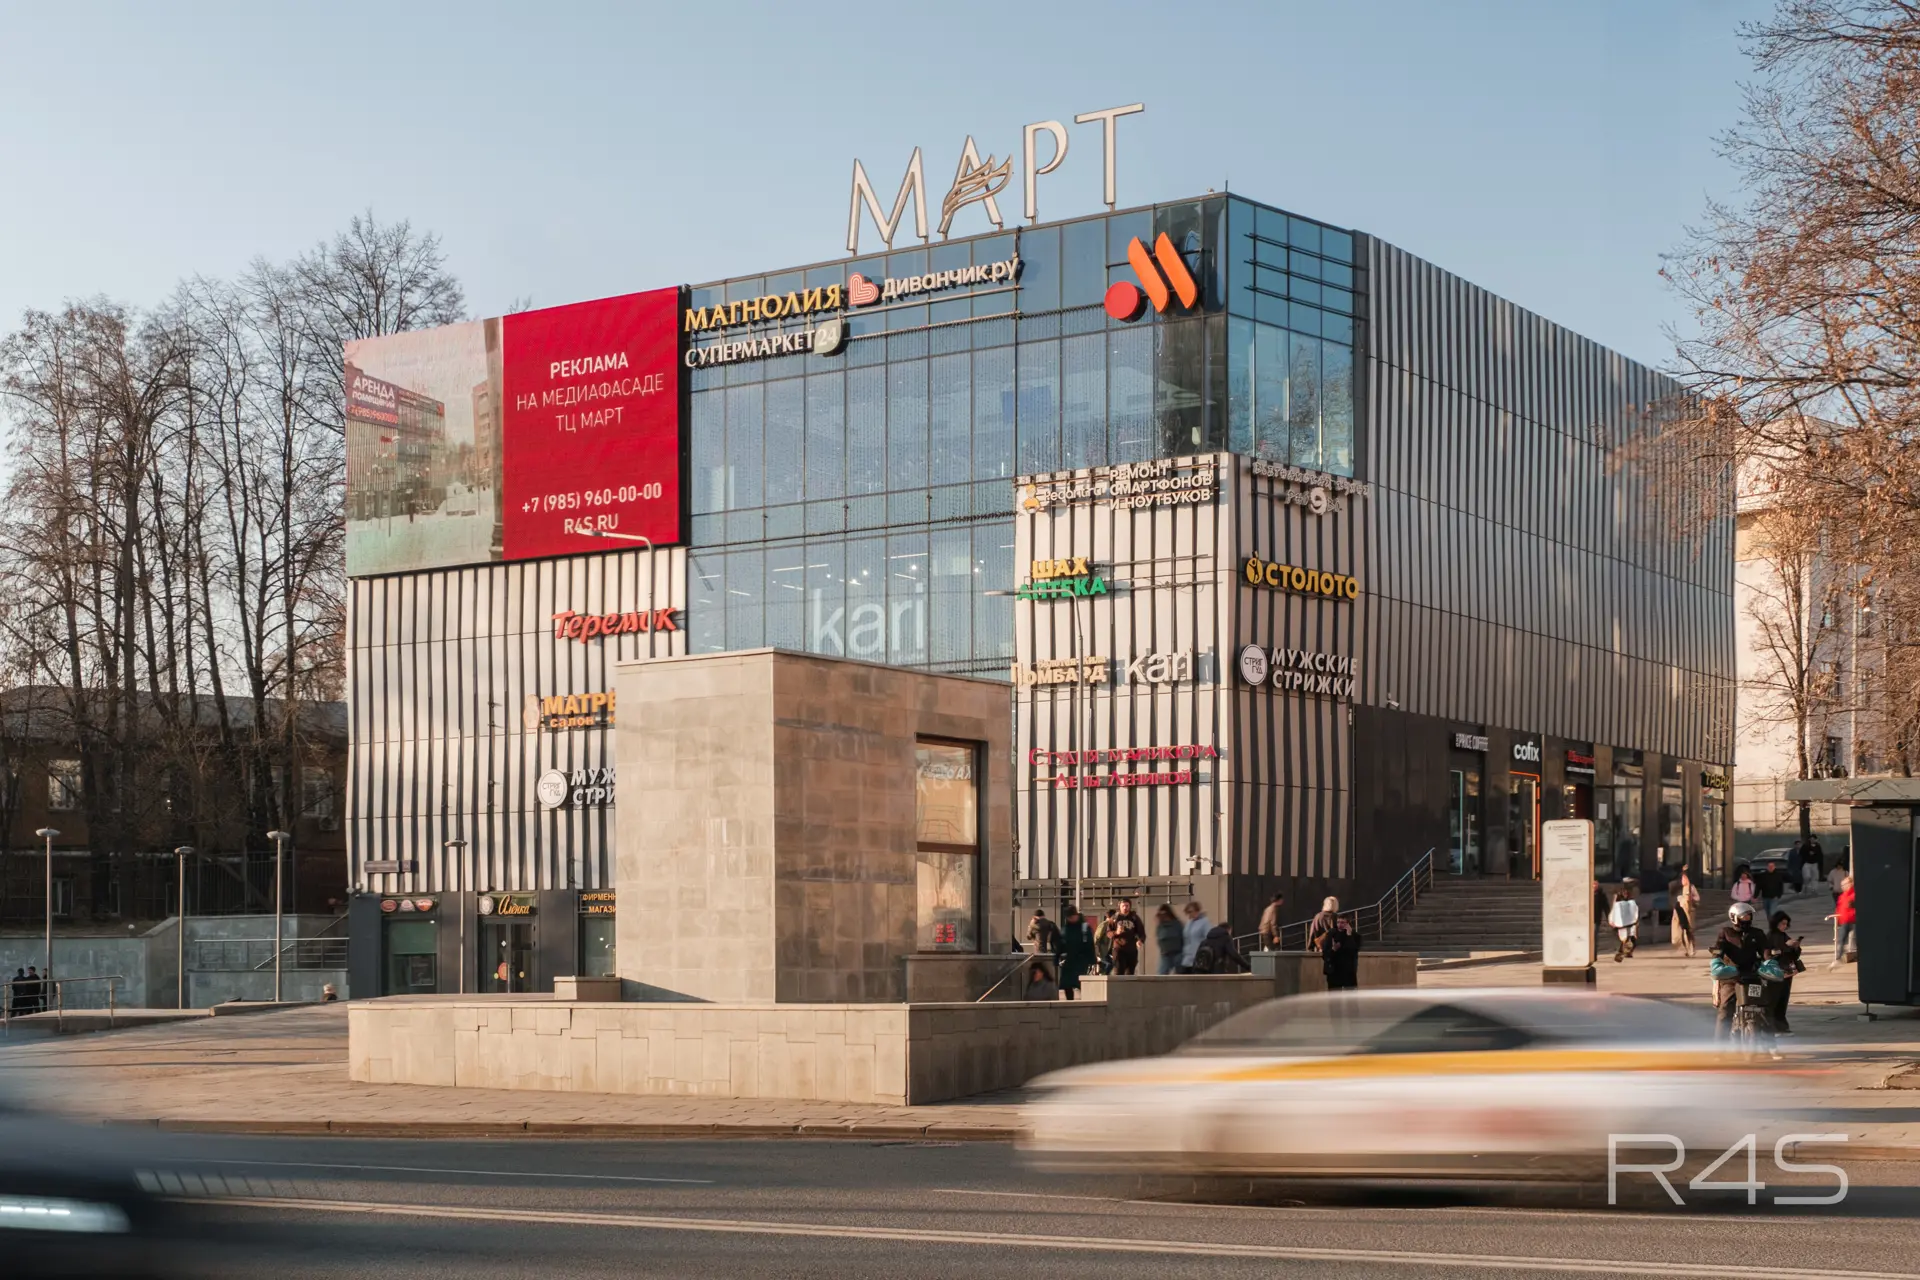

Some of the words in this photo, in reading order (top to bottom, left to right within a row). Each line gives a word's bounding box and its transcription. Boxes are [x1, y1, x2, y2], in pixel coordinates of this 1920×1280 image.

[847, 103, 1145, 251] МАРТ
[684, 284, 843, 332] МАГНОЛИЯ
[685, 330, 815, 368] СУПЕРМАРКЕТ
[818, 327, 838, 346] 24
[550, 351, 629, 379] РЕКЛАМА
[352, 375, 395, 400] АРЕНДА
[517, 393, 538, 411] НА
[542, 373, 665, 407] МЕДИАФАСАДЕ
[555, 414, 577, 433] ТЦ
[580, 407, 624, 428] МАРТ
[1110, 465, 1168, 481] РЕМОНТ
[1110, 475, 1214, 496] СМАРТФОНОВ
[522, 497, 539, 513] +7
[543, 491, 581, 513] (985)
[584, 482, 662, 507] 960-00-00
[1110, 498, 1120, 510] И
[1125, 488, 1211, 509] НОУТБУКОВ
[564, 513, 619, 535] R4S.RU
[1032, 557, 1088, 579] ШАХ
[1265, 562, 1360, 599] СТОЛОТО
[1016, 576, 1107, 601] АПТЕКА
[552, 607, 677, 644] Теремок
[813, 582, 924, 655] kari
[1124, 644, 1193, 684] kari
[1270, 646, 1359, 676] МУЖСКИЕ
[1272, 670, 1356, 697] СТРИЖКИ
[1513, 741, 1539, 762] cofix
[1706, 772, 1729, 792] ТАБАК
